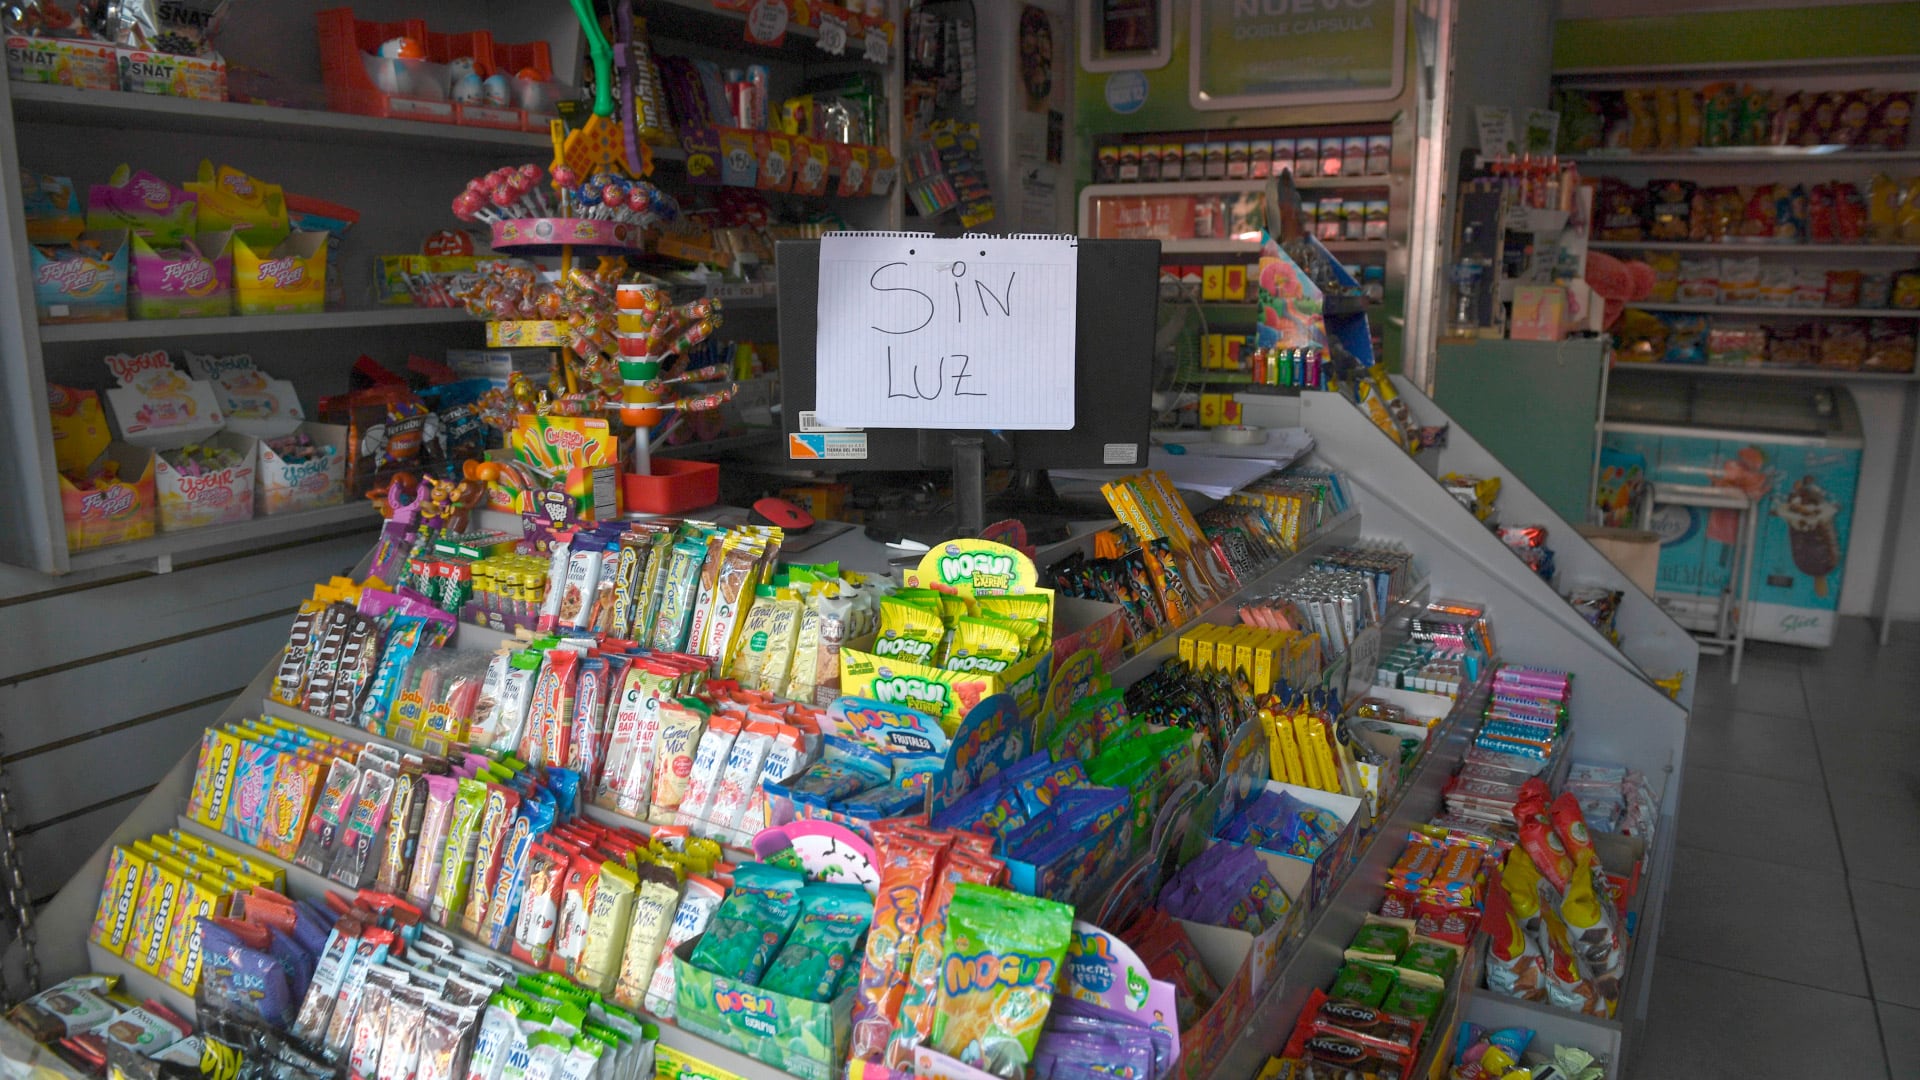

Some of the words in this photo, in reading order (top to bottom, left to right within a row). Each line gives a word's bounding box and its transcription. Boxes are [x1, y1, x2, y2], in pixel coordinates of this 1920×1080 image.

[157, 1, 214, 26] SNAT
[8, 50, 57, 66] SNAT
[131, 62, 174, 79] SNAT
[886, 344, 988, 401] LUZ
[941, 553, 1016, 585] MOGUL
[876, 638, 934, 661] MOGUL
[948, 656, 1010, 676] MOGUL
[875, 678, 950, 707] MOGUL
[1496, 694, 1542, 708] mentos
[399, 703, 422, 721] doll
[906, 696, 946, 719] EXTREME
[617, 722, 633, 732] BAR
[846, 709, 930, 735] MOGUL
[1507, 711, 1555, 725] mentos
[636, 731, 654, 742] BAR
[662, 724, 698, 742] Cereal
[892, 732, 932, 751] FRUTALES
[661, 738, 688, 757] Mix
[764, 760, 788, 780] MIX
[208, 743, 233, 821] sugus
[1034, 764, 1088, 807] MOGUL
[110, 864, 138, 946] sugus
[145, 881, 175, 967] sugus
[634, 910, 658, 929] Mix
[945, 954, 1056, 996] MOGUL
[715, 990, 777, 1019] MOGUL
[1324, 1001, 1374, 1021] ARCOR
